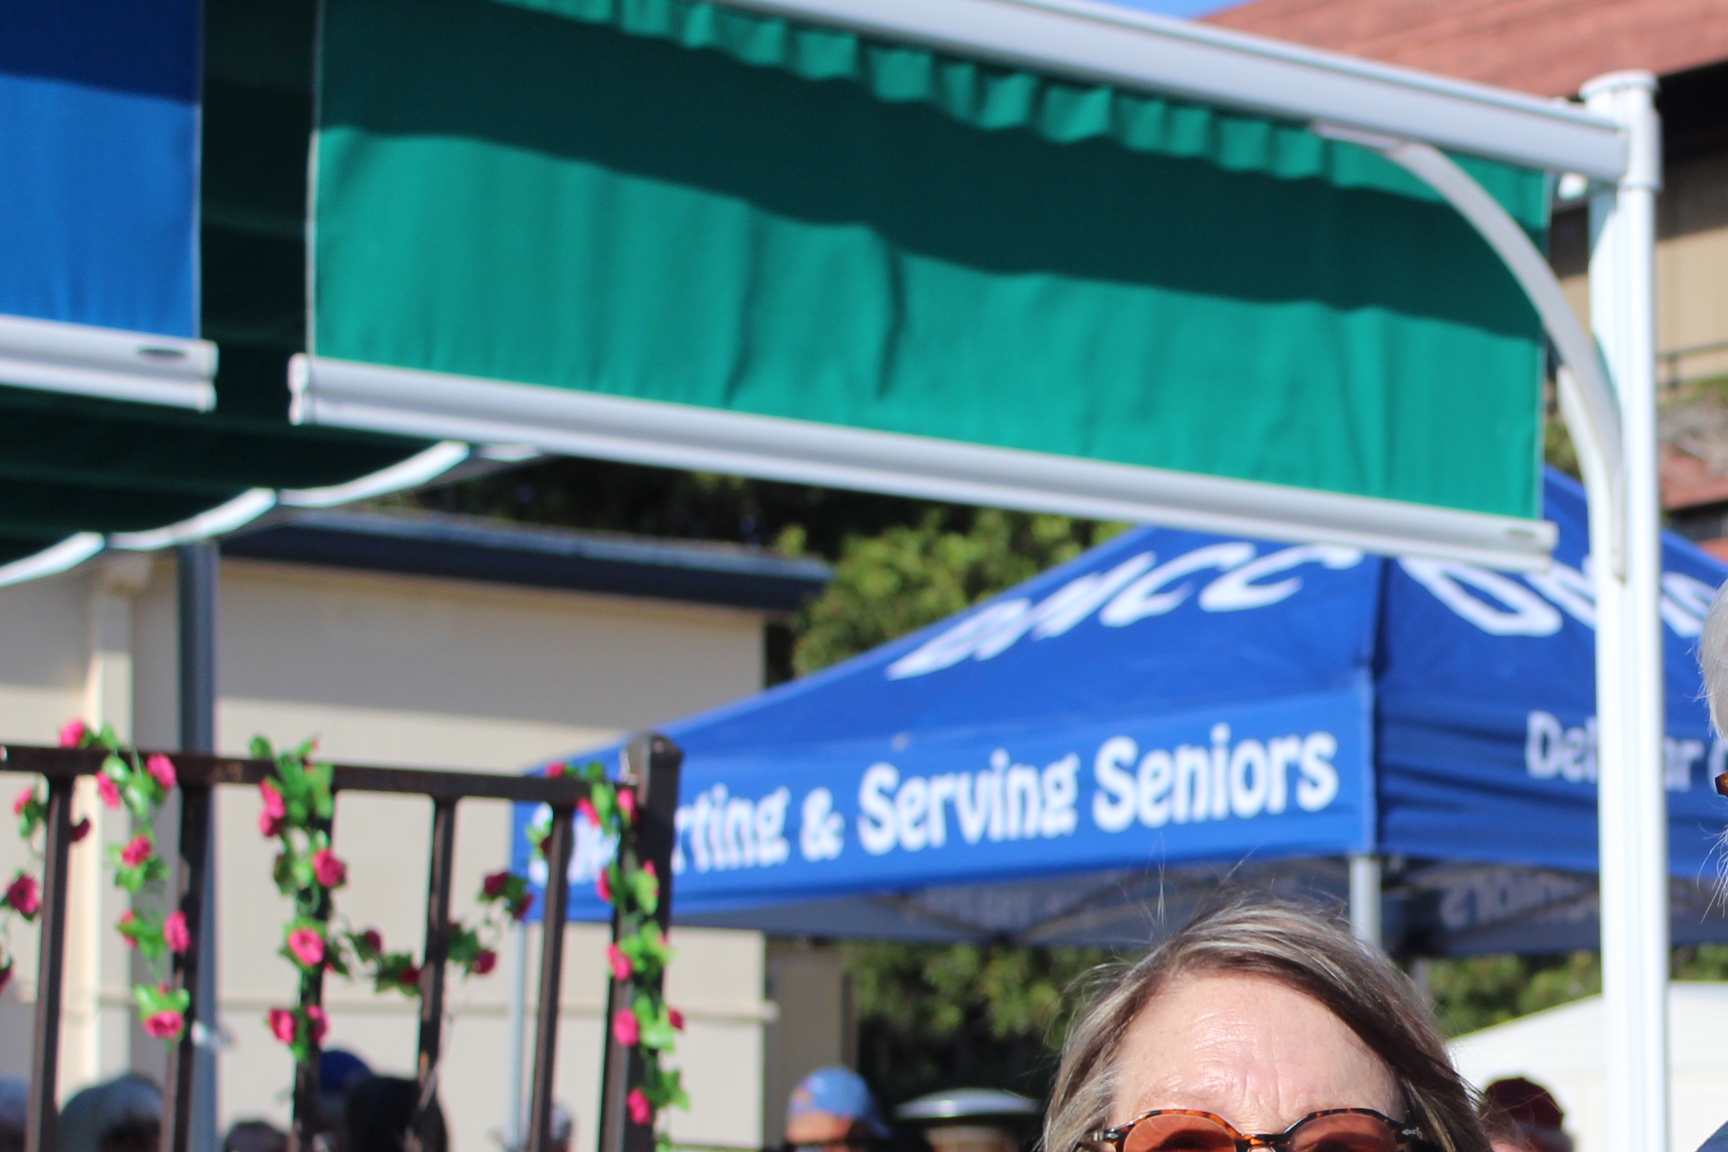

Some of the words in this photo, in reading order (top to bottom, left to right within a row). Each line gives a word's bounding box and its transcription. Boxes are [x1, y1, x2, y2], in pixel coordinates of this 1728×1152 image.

[801, 787, 845, 862] &
[857, 748, 1080, 856] Serving
[1092, 722, 1339, 833] Seniors
